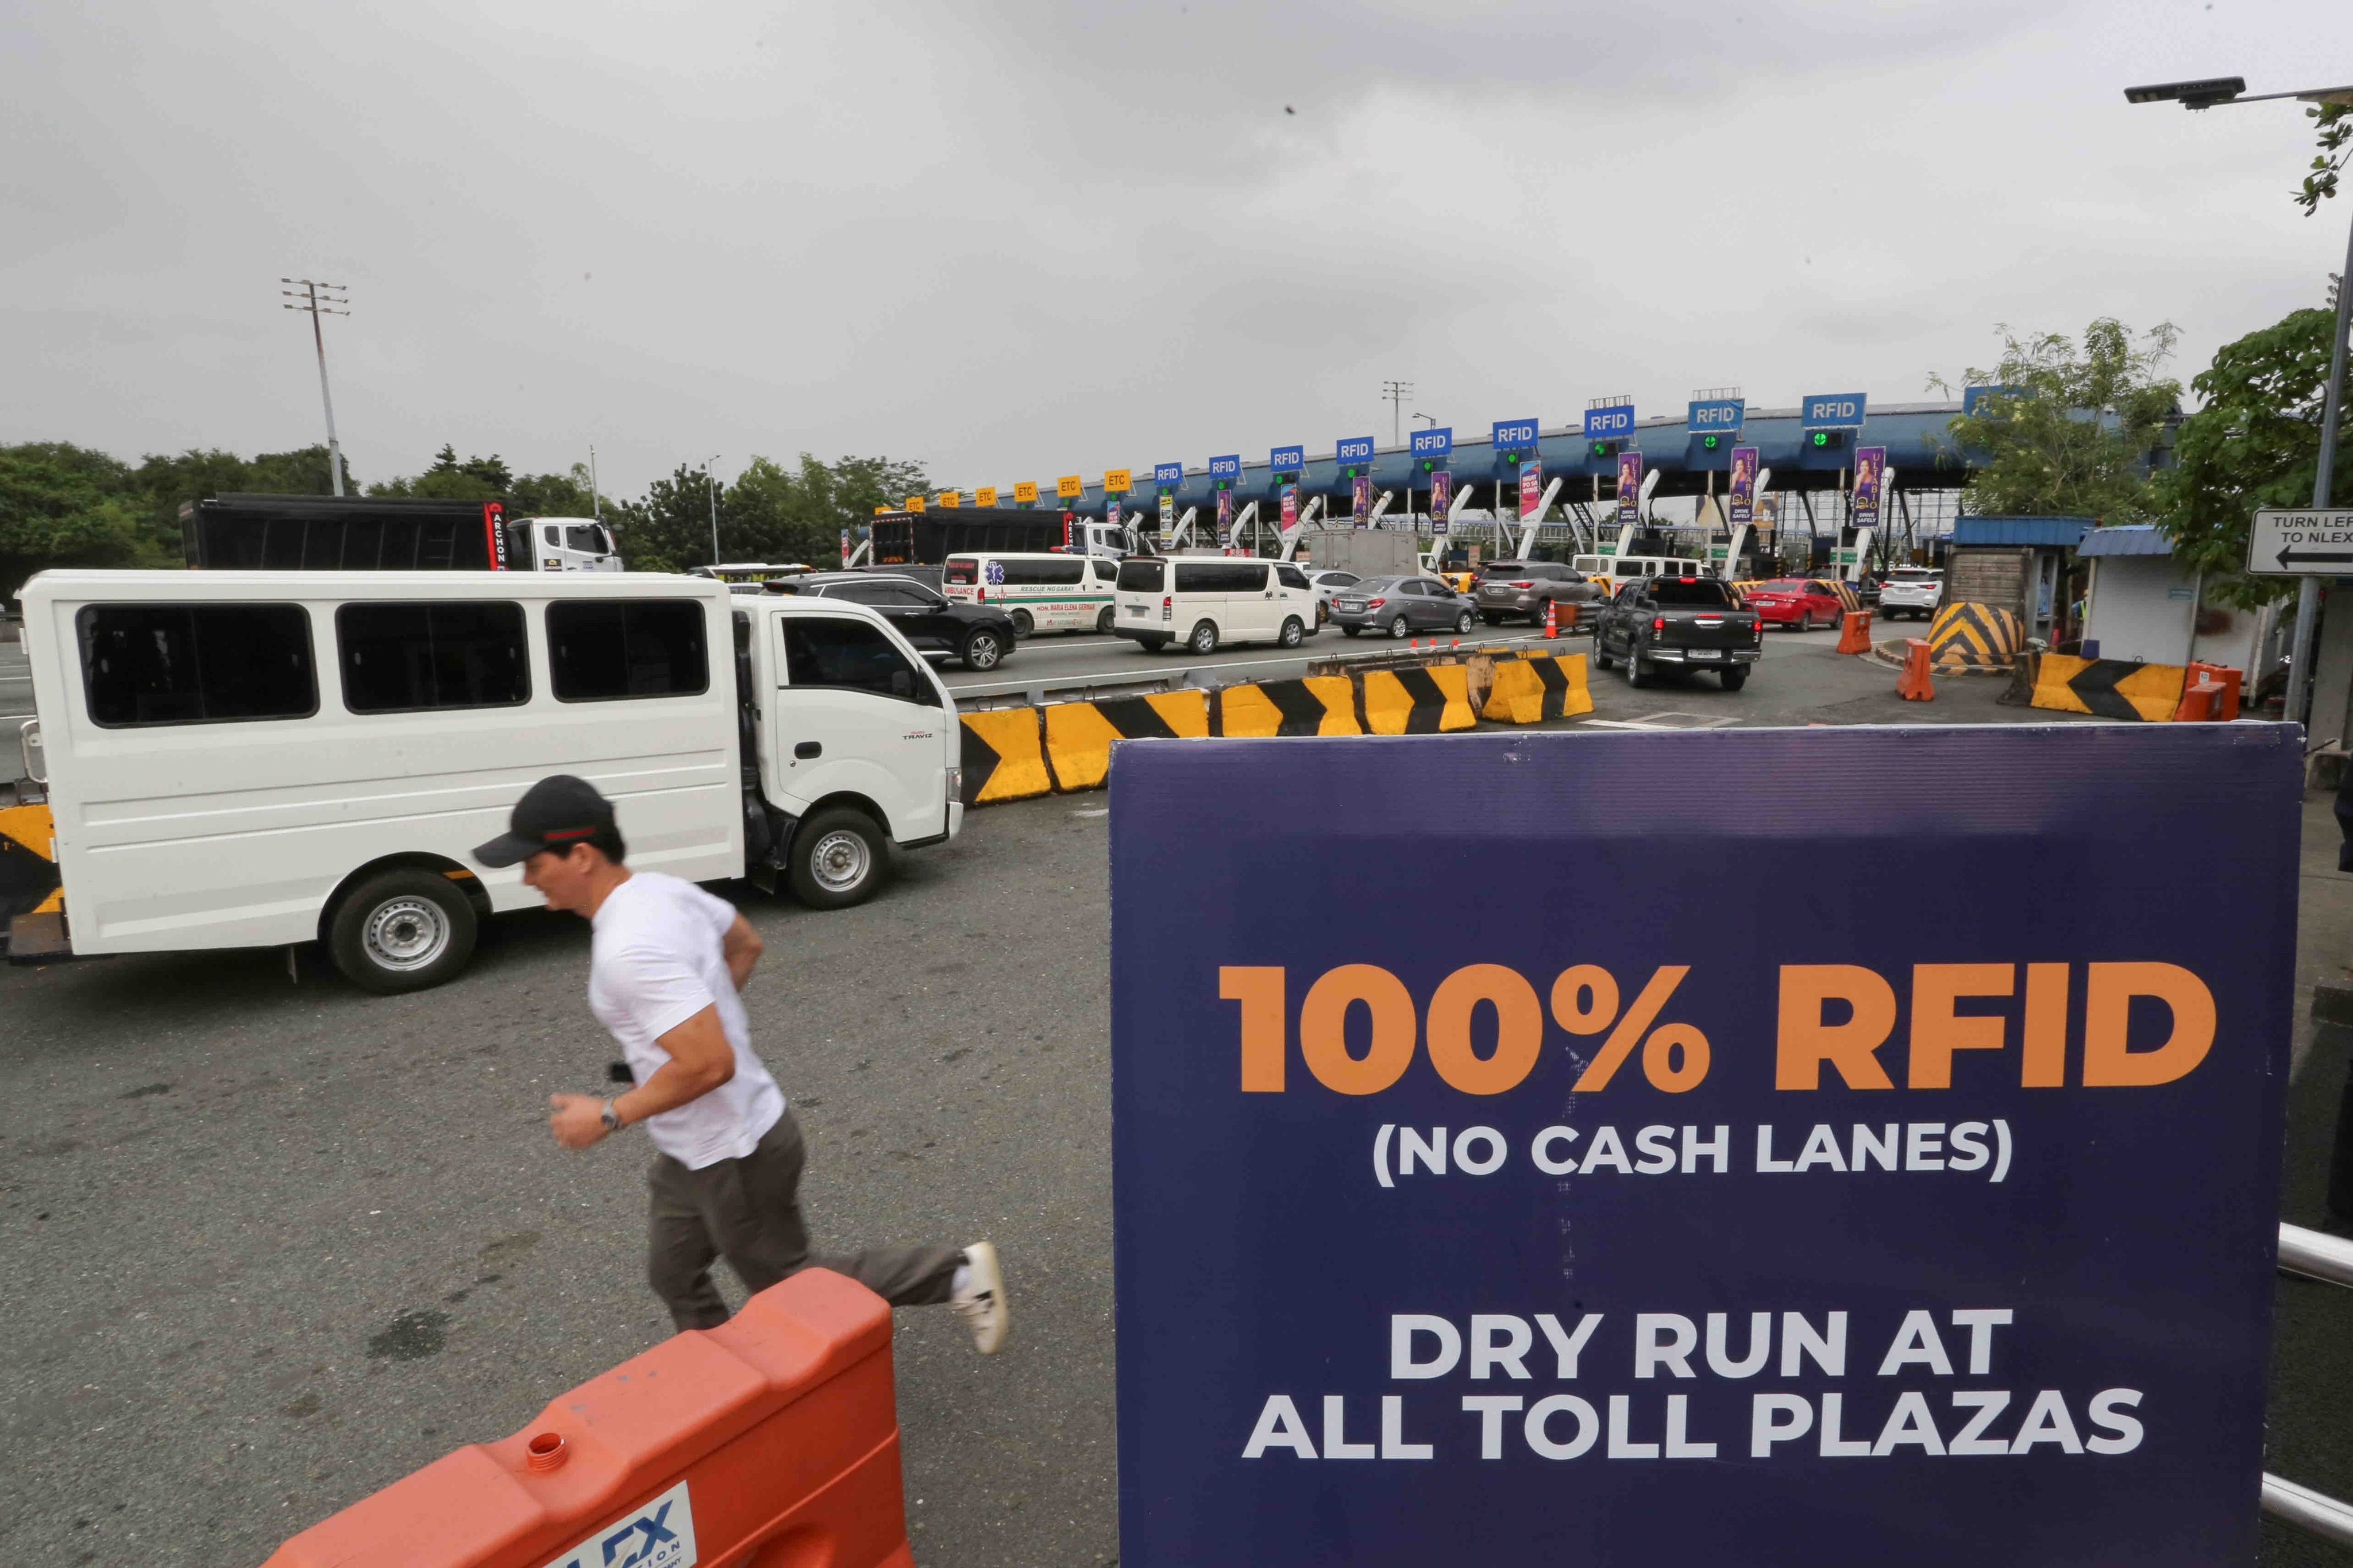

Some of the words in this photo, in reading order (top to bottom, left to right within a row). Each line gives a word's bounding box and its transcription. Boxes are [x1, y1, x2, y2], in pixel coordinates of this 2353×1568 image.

[1696, 407, 1735, 423] RFID
[1812, 402, 1856, 419] RFID
[1591, 414, 1627, 431] RFID
[1498, 426, 1533, 443] RFID
[1341, 443, 1368, 458] RFID
[1415, 435, 1446, 451] RFID
[1274, 452, 1299, 466] RFID
[1158, 468, 1178, 481] RFID
[1213, 461, 1235, 474] RFID
[1061, 481, 1076, 491] ETC
[1109, 474, 1125, 486] ETC
[1744, 453, 1754, 506] ULTABIO
[1869, 453, 1880, 509] ULTABIO
[979, 492, 992, 501] ETC
[1018, 487, 1032, 496] ETC
[909, 501, 920, 511] ETC
[943, 497, 955, 507] ETC
[2273, 517, 2318, 527] TURN
[2324, 516, 2353, 527] LEF
[493, 514, 506, 562] ARCHON
[2281, 532, 2303, 543] TO
[2308, 532, 2353, 543] NLEX
[944, 586, 975, 595] AMBULANCE
[1220, 964, 1711, 1096] 100%
[1776, 962, 2218, 1091] RFID
[1374, 1124, 1508, 1188] (NO
[1531, 1125, 1730, 1176] CASH
[1756, 1118, 2013, 1183] LANES)
[1391, 1314, 1605, 1380] DRY
[1635, 1311, 1848, 1379] RUN
[1877, 1308, 2013, 1376] AT
[1241, 1395, 1434, 1460] ALL
[1462, 1394, 1718, 1461] TOLL
[1751, 1387, 2144, 1458] PLAZAS
